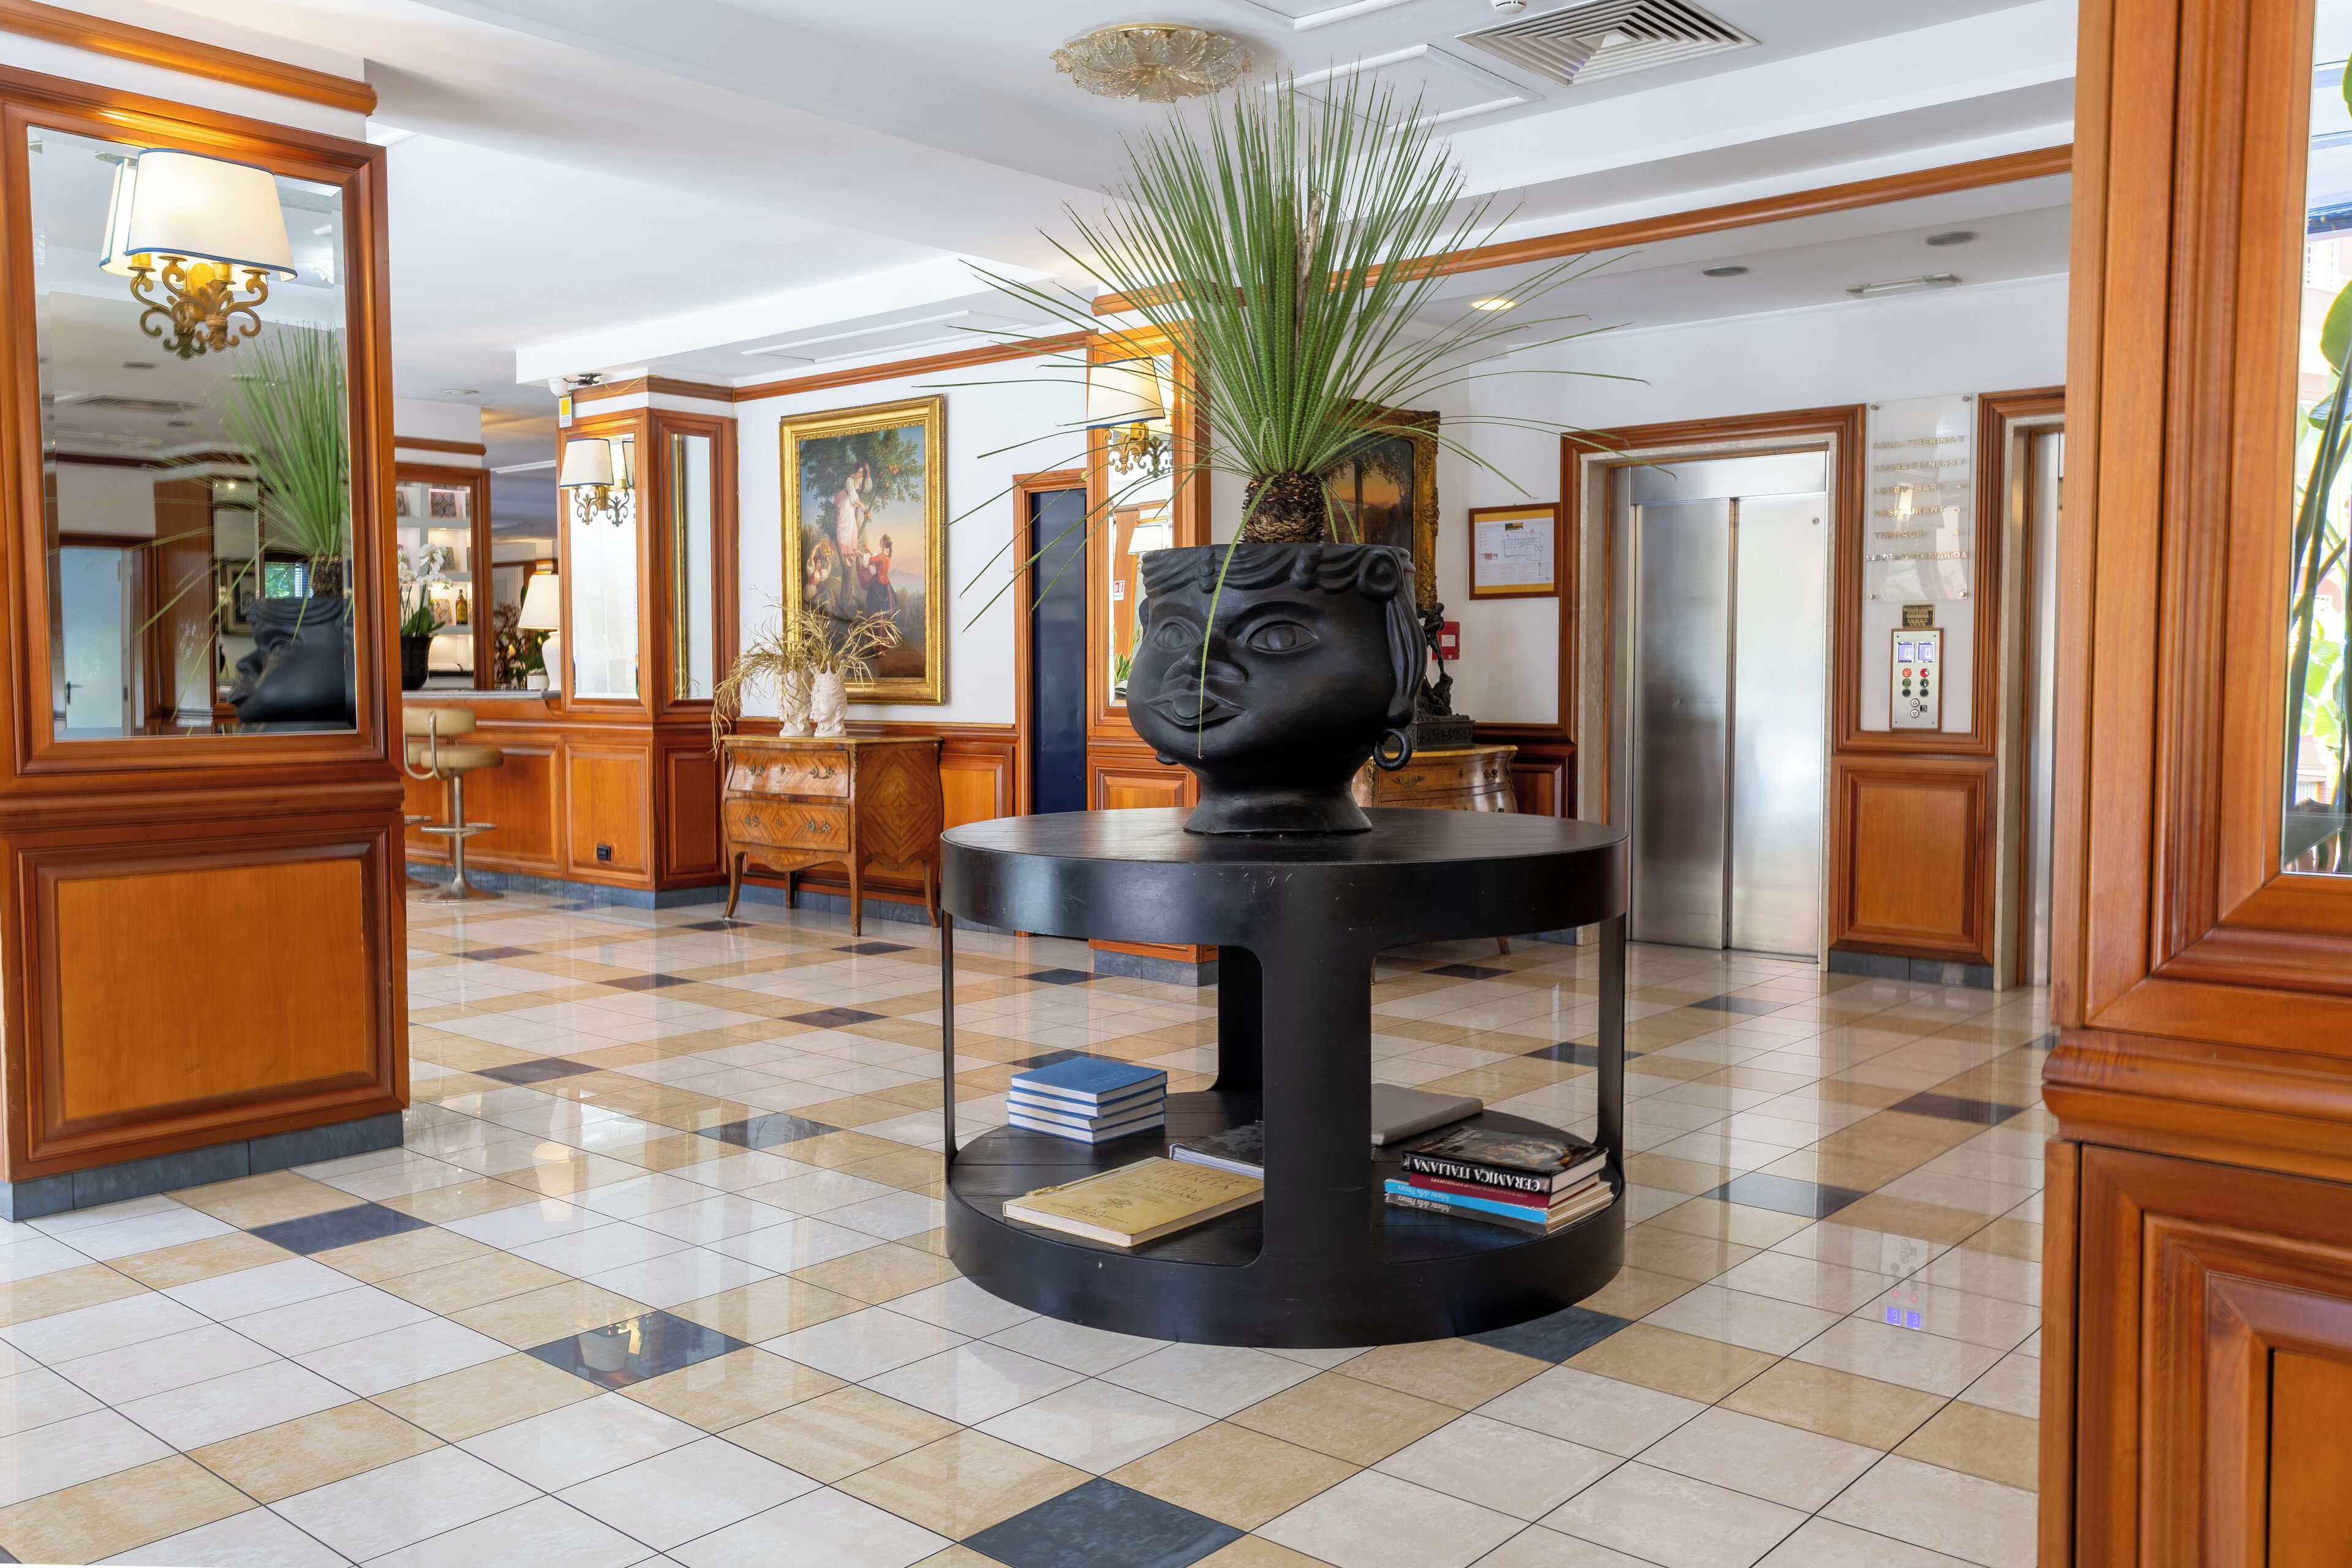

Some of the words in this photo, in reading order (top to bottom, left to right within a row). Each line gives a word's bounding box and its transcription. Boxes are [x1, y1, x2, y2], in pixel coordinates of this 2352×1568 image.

[1873, 440, 1901, 450] SALA
[1906, 436, 1955, 447] TIBERINA
[1873, 462, 1908, 472] SAUNA
[1912, 459, 1956, 469] FITNESS
[1874, 485, 1908, 496] LOBBY
[1874, 506, 1945, 517] RESTAURANT
[1874, 530, 1923, 540] TERRACE
[1894, 551, 1927, 560] MONTE
[1929, 551, 1961, 560] MARIO
[1904, 648, 1911, 658] 0
[1924, 648, 1931, 658] 0
[1413, 1158, 1470, 1179] ITALIANA
[1154, 1170, 1229, 1189] D'ITALIA
[1164, 1166, 1247, 1185] BELLEZZE
[1474, 1168, 1540, 1192] CERAMICA
[1145, 1185, 1202, 1201] VATICANO
[1417, 1188, 1430, 1197] della
[1430, 1192, 1451, 1202] Atlante
[1417, 1199, 1430, 1209] della
[1430, 1202, 1452, 1213] Atlante
